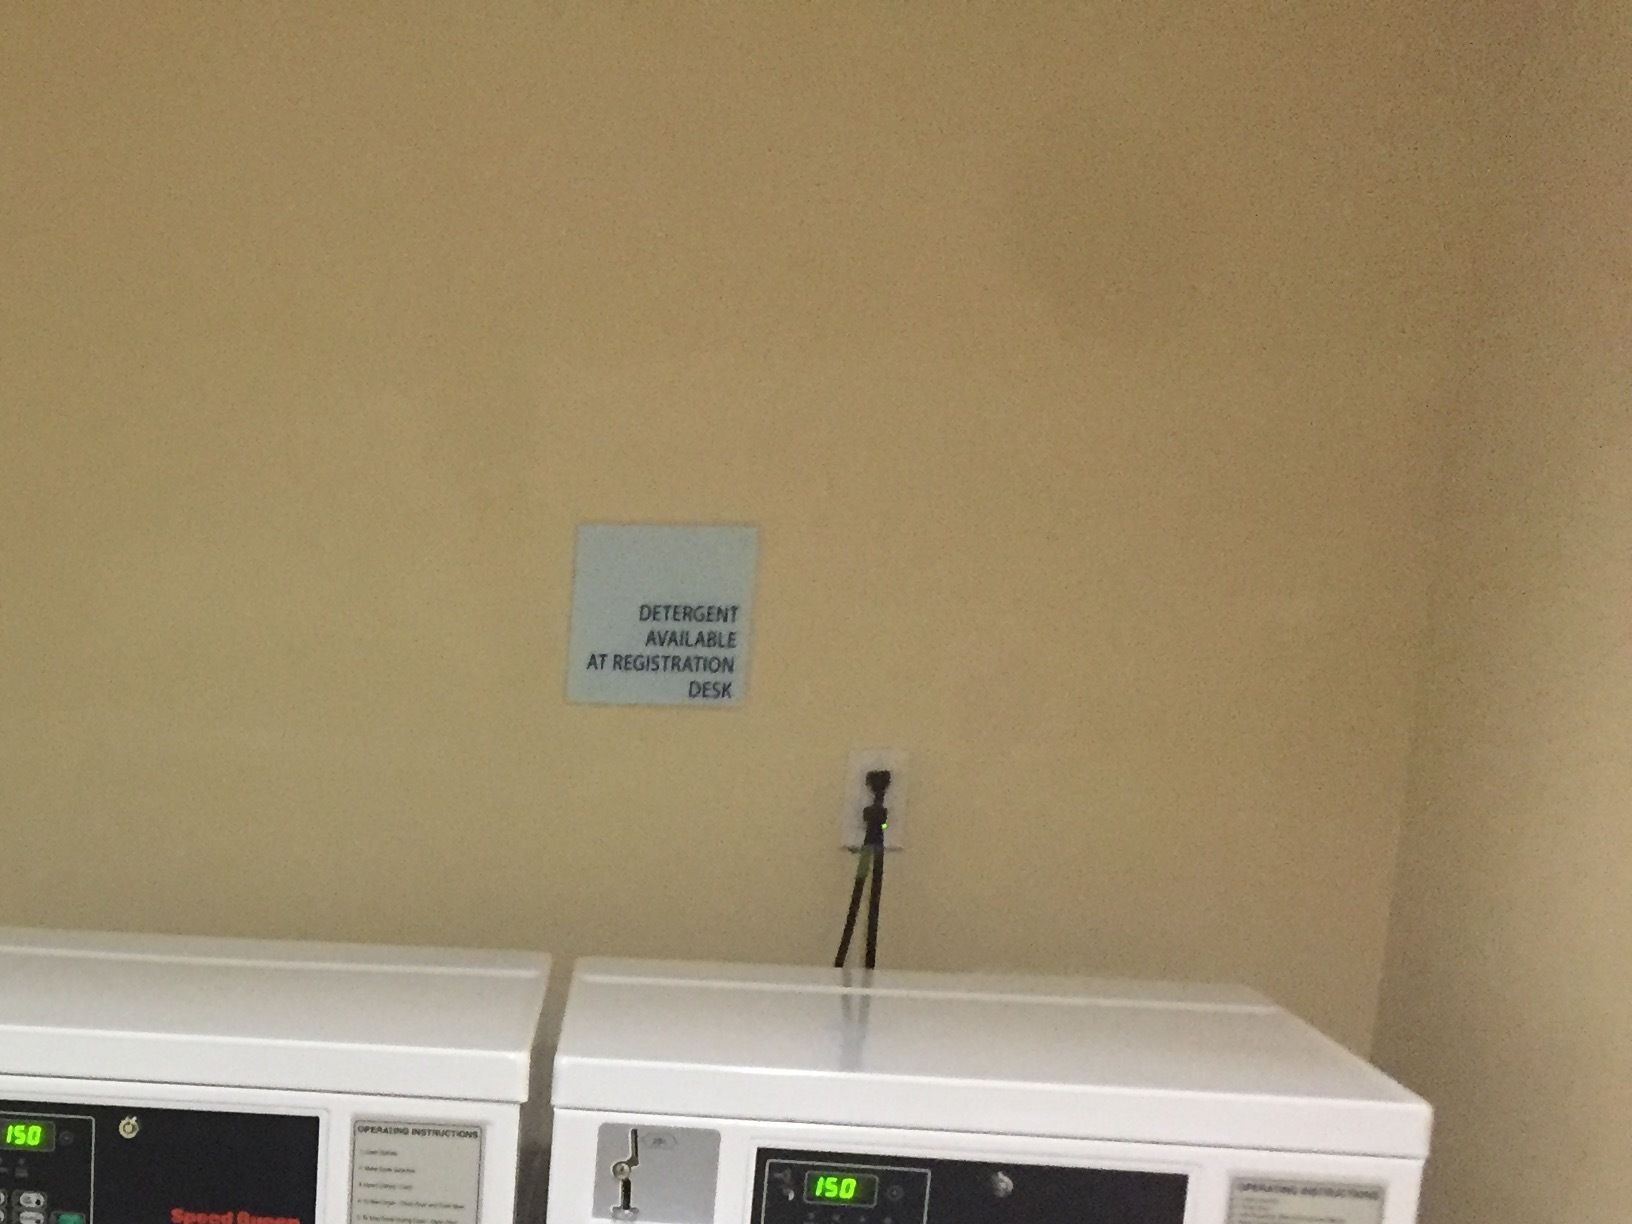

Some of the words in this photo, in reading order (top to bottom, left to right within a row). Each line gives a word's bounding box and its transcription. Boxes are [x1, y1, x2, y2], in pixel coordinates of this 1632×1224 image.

[639, 604, 738, 622] DETERGENT
[645, 630, 736, 648] AVAILABLE
[586, 653, 608, 670] AT
[613, 654, 734, 673] REGISTRATION
[688, 680, 732, 698] DESK
[6, 1125, 42, 1146] 150
[412, 1128, 479, 1139] INSTRUCTIONS
[815, 1176, 857, 1199] 150
